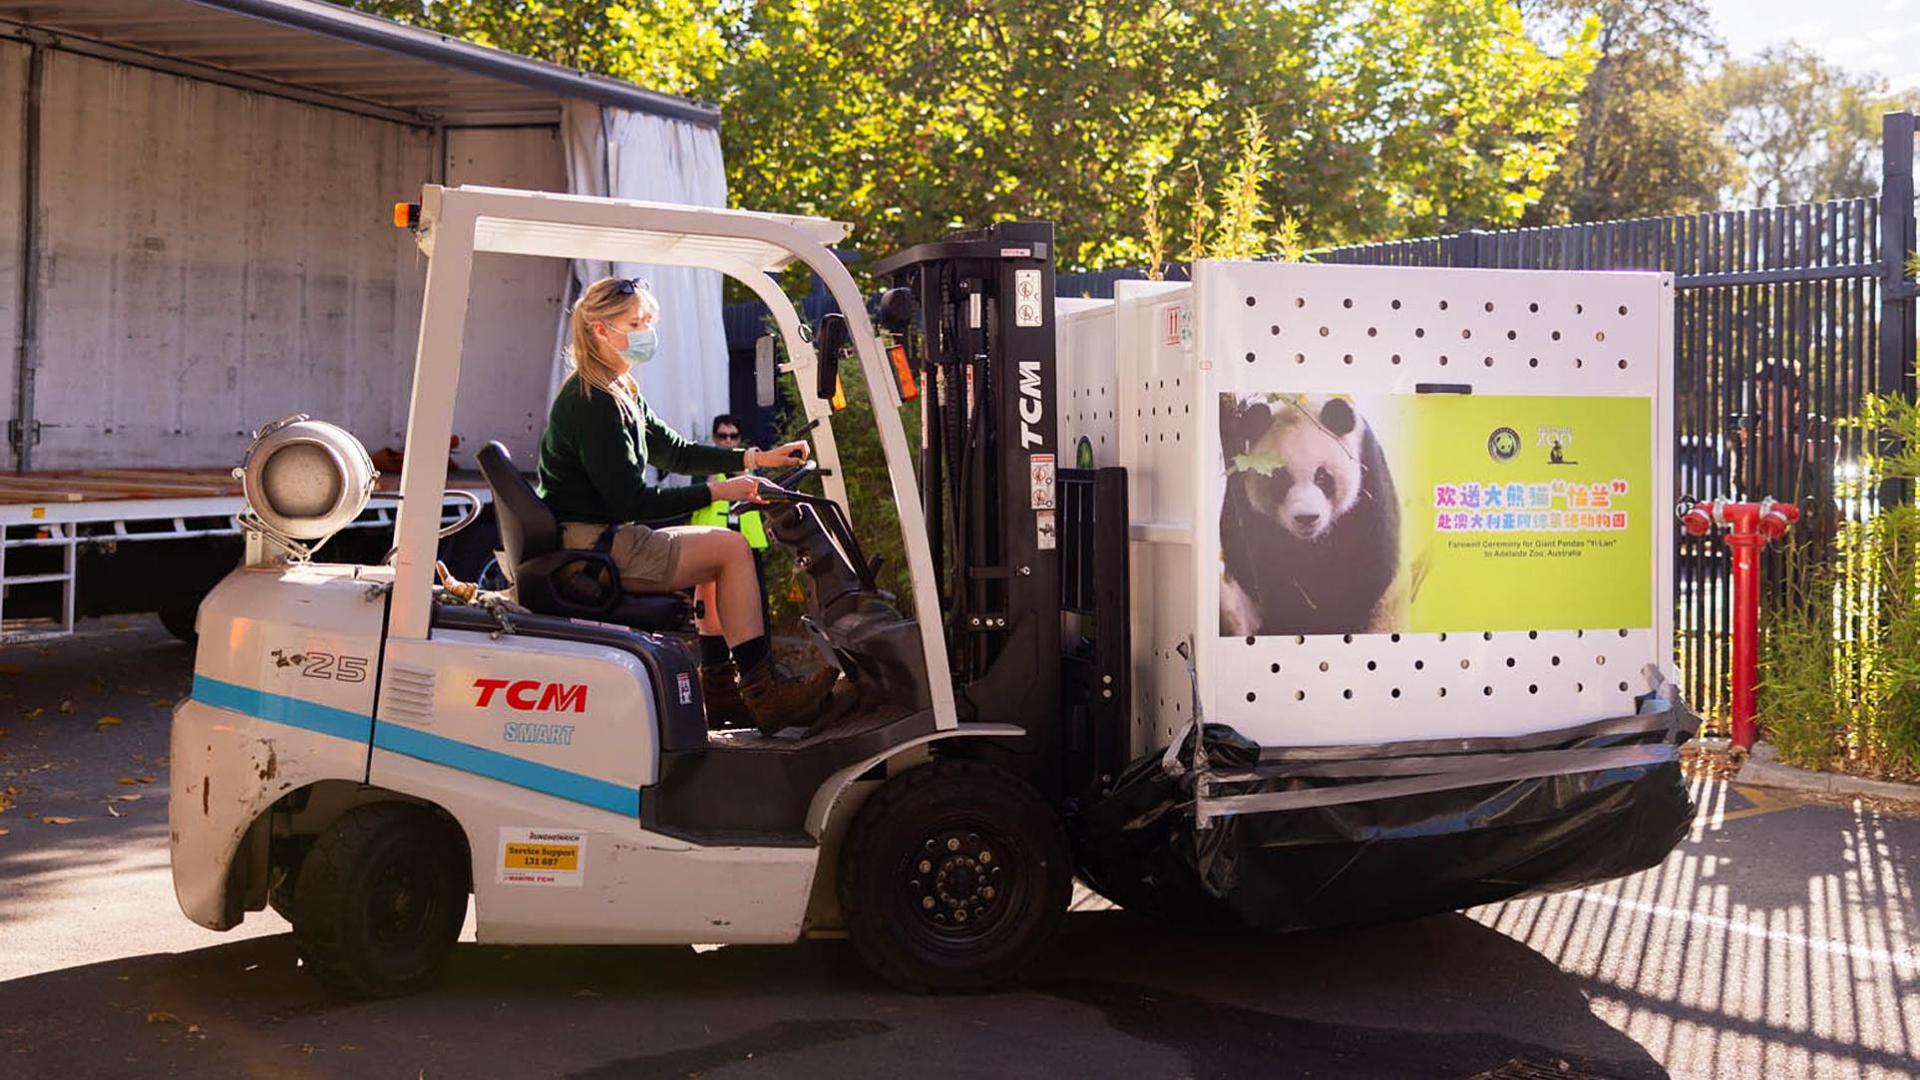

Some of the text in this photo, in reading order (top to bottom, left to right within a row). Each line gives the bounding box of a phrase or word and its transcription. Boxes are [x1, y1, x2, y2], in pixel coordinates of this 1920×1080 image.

[1019, 361, 1043, 450] TCM
[1482, 541, 1520, 549] Ceremony
[1548, 549, 1581, 557] Australia
[303, 651, 368, 683] 25
[473, 678, 588, 713] TCM
[503, 722, 575, 745] SMART
[509, 847, 576, 857] Service Support
